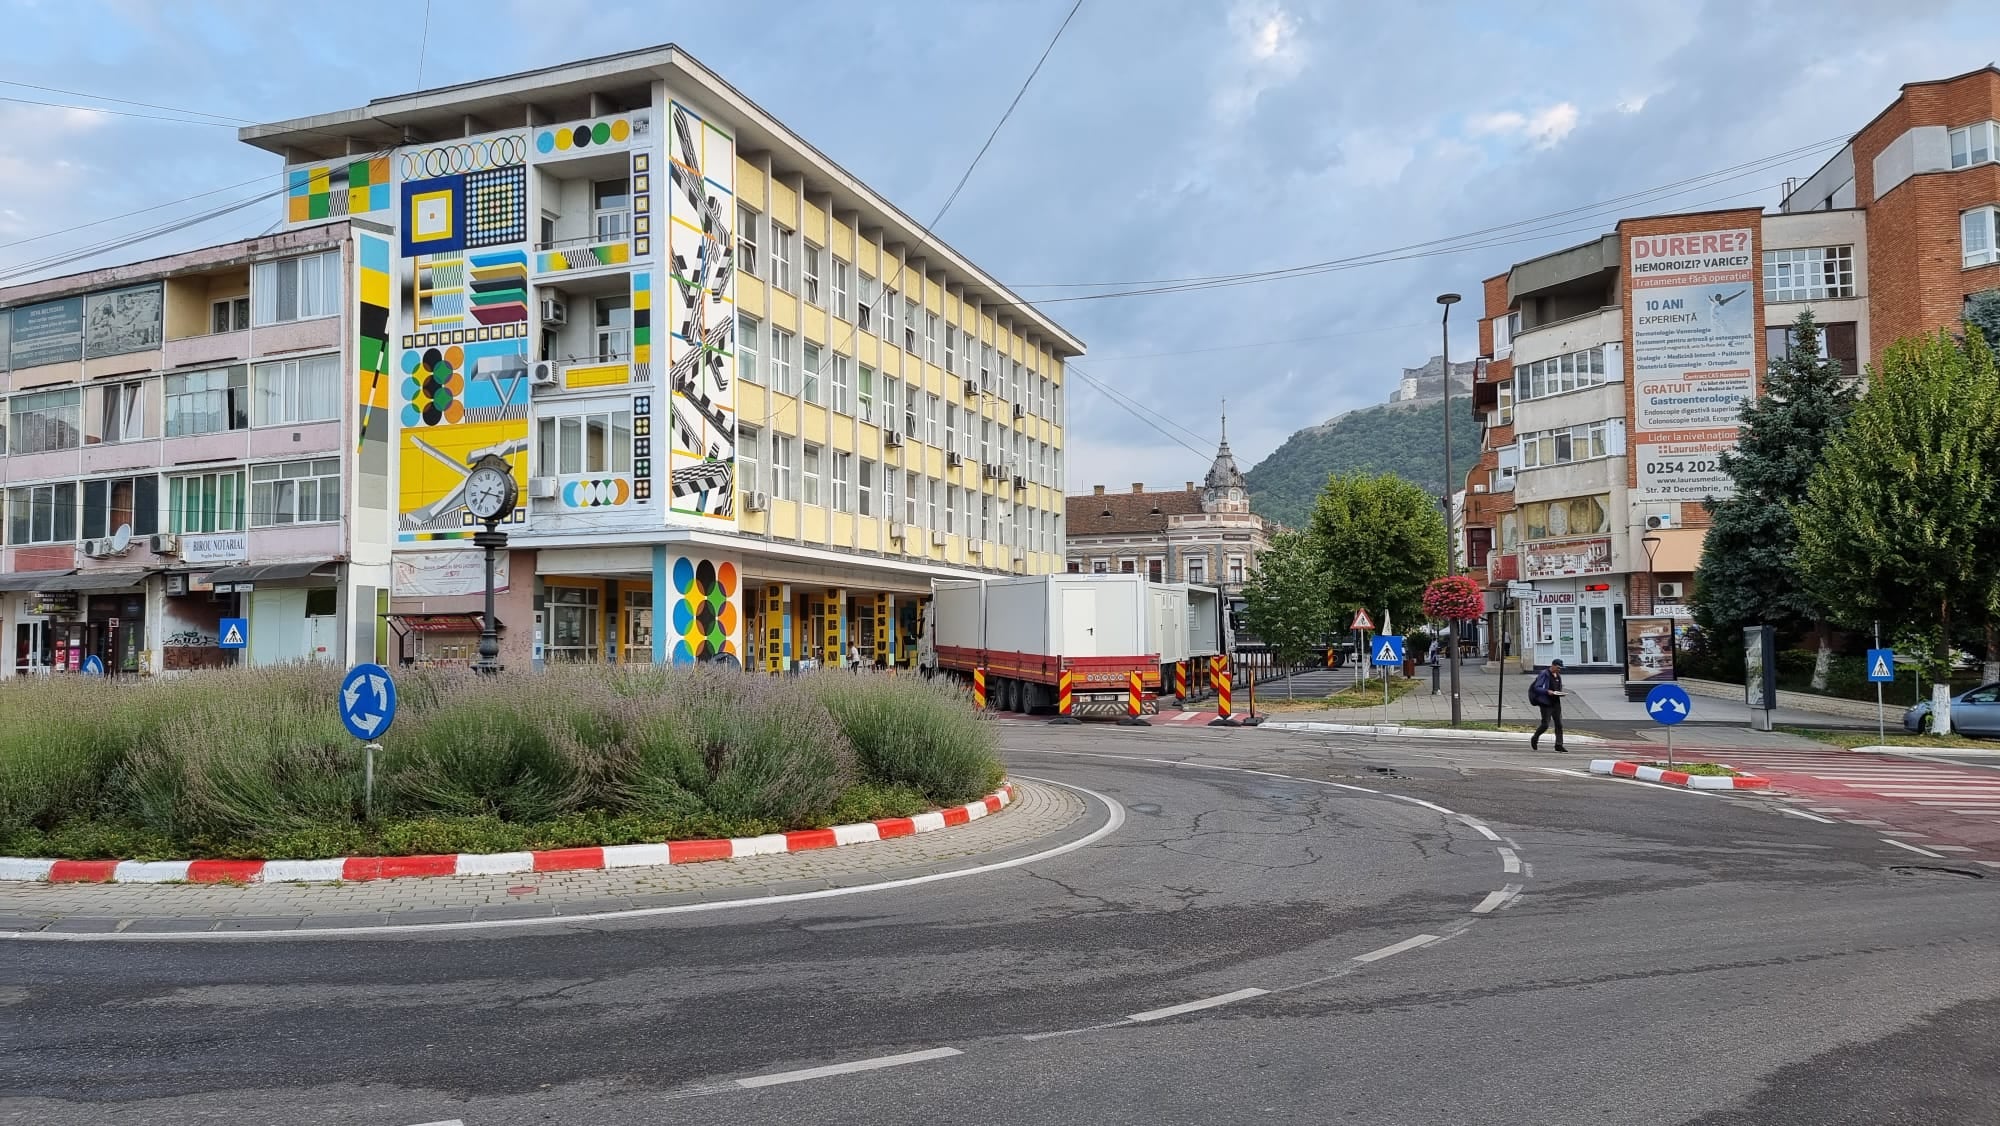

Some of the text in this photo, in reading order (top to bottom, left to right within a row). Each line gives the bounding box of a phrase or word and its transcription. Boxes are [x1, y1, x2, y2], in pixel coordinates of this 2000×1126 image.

[1635, 232, 1748, 259] DURERE?
[1634, 256, 1748, 273] HEMOROIZI? VARICE?
[1636, 277, 1686, 288] Tratamente
[1689, 274, 1707, 283] fără
[1646, 298, 1684, 311] 10 ANI
[1643, 383, 1692, 394] GRATUIT
[1650, 394, 1740, 405] Gastroenterologie
[1683, 432, 1705, 440] nivel
[1646, 460, 1715, 474] 0254 202
[1674, 485, 1720, 493] Decembrie,
[213, 538, 244, 550] NOTARIAL
[770, 586, 779, 611] DE
